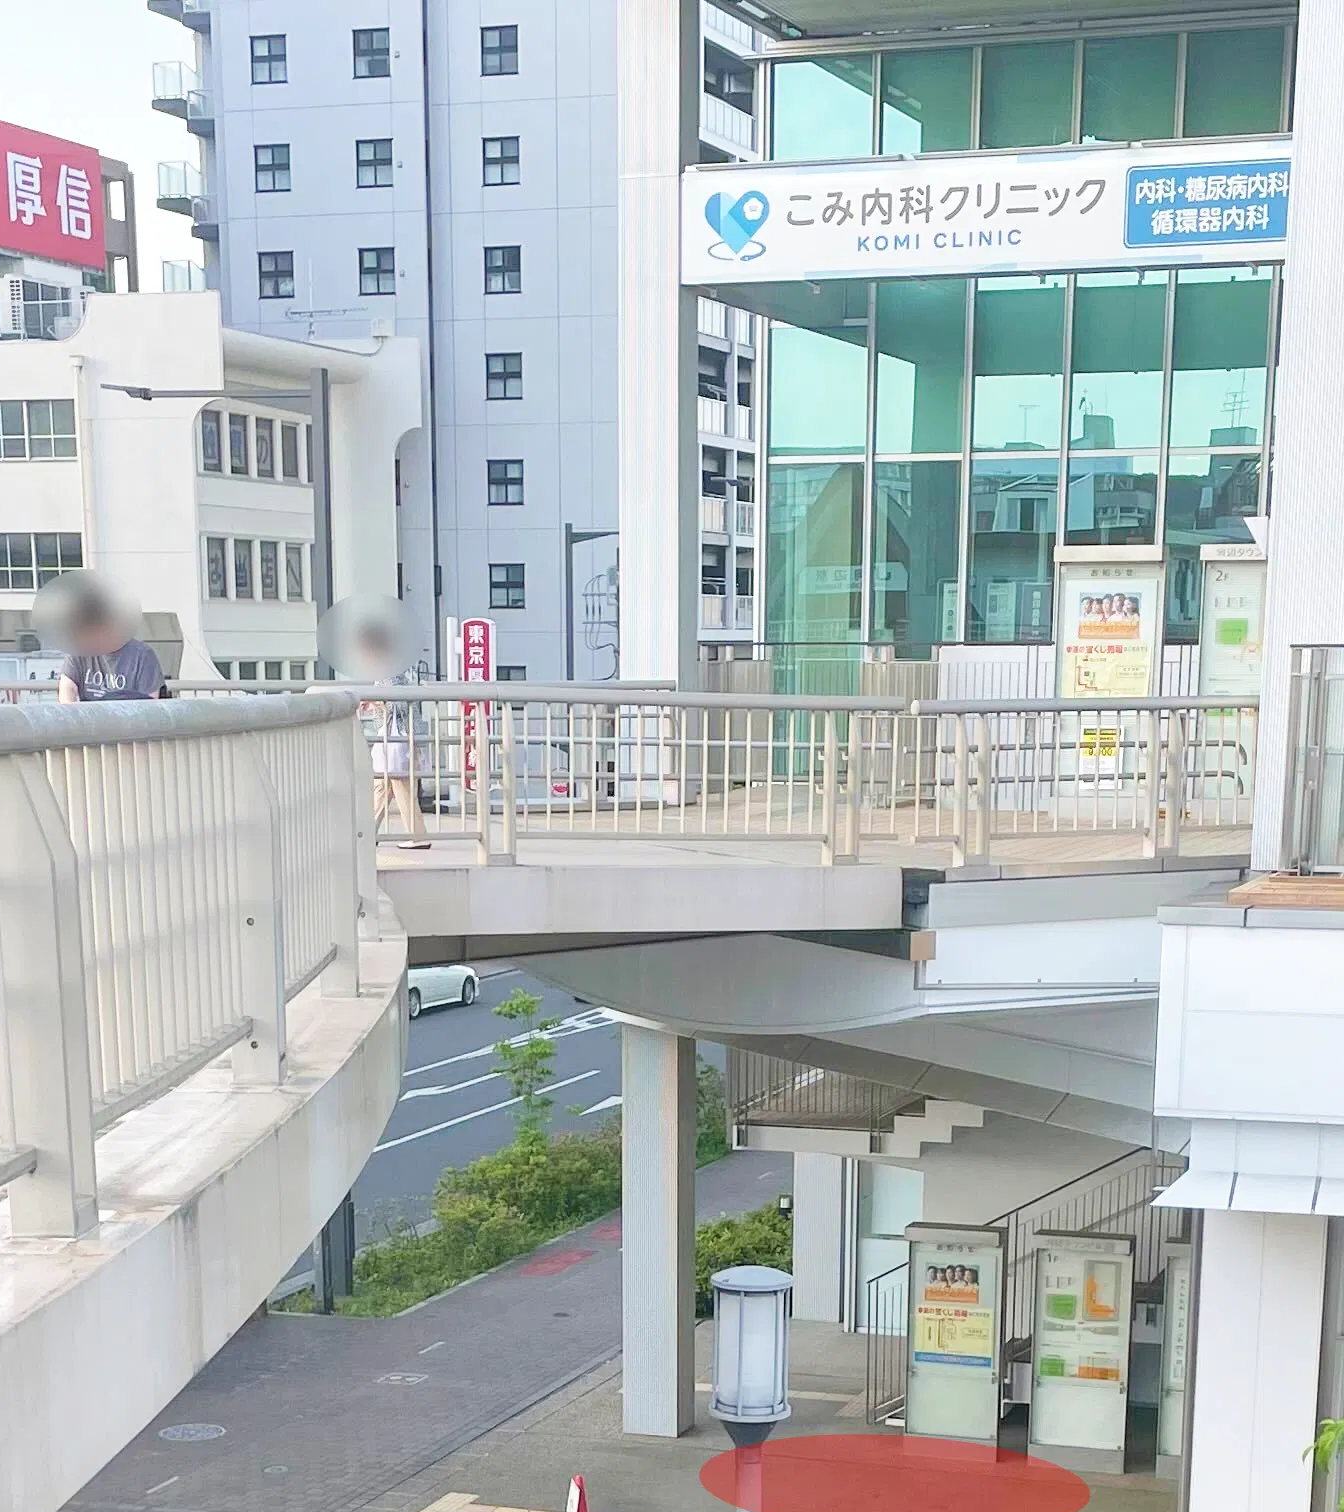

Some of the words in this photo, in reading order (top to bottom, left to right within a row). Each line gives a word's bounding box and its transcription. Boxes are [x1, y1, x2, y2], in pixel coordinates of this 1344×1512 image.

[6, 151, 93, 241] 厚信
[787, 179, 1107, 226] こみ内科クリニック
[1150, 203, 1271, 236] 循環器内科
[857, 232, 920, 252] KOMI
[933, 228, 1023, 249] CLINIC
